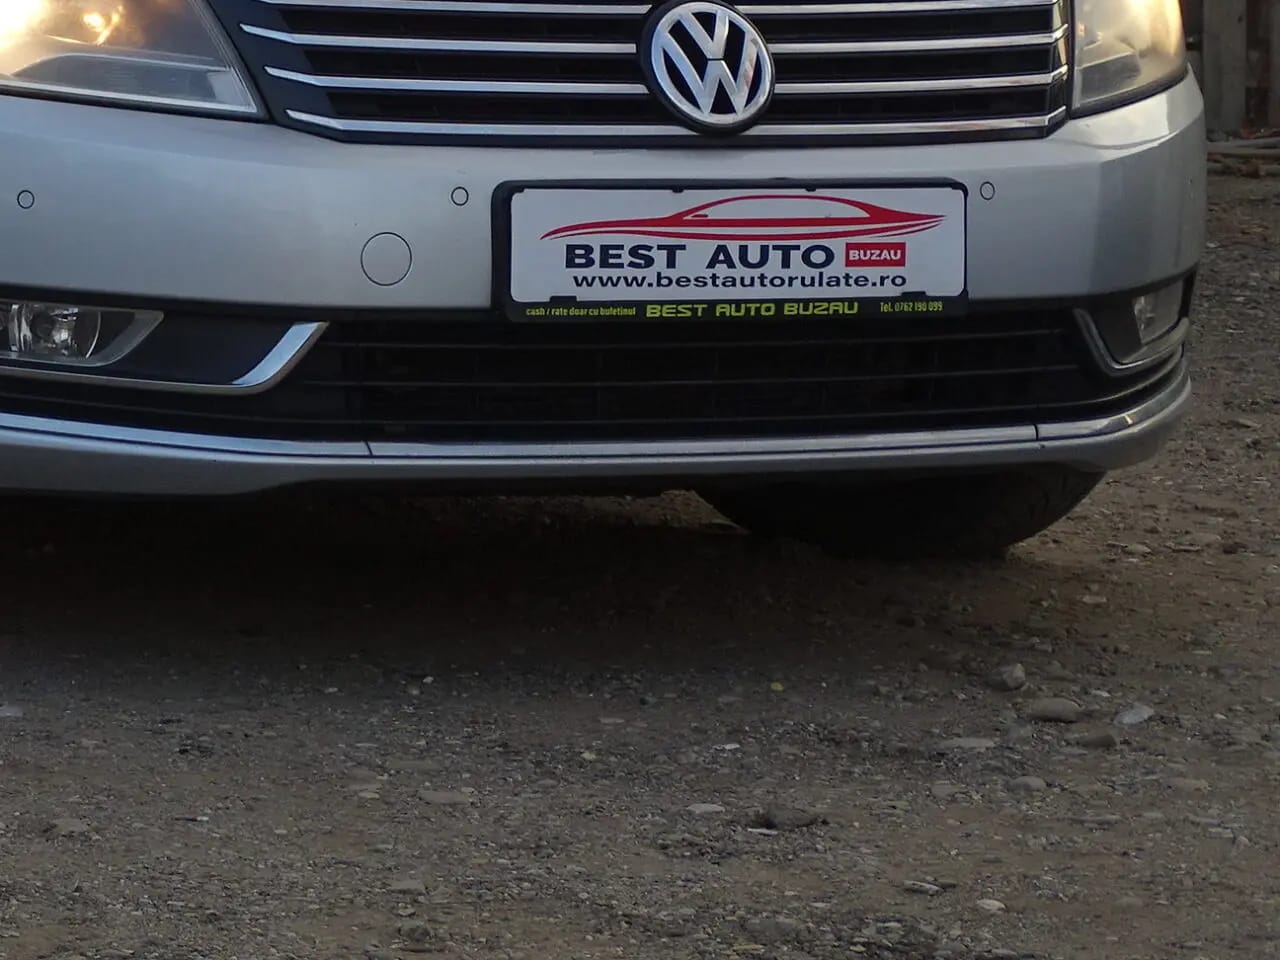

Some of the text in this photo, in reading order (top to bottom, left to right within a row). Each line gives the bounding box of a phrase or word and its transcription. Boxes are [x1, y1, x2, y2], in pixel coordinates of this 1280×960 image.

[565, 243, 902, 270] BEST AUTO BUZAU
[573, 272, 907, 289] www.bestautorulate.ro
[526, 306, 546, 316] cash
[551, 306, 569, 316] rate
[569, 306, 588, 316] doar
[589, 307, 600, 316] cu
[600, 305, 637, 317] buletinul
[645, 304, 708, 318] BEST
[715, 303, 777, 318] AUTO
[783, 301, 860, 316] BUZAU
[880, 301, 894, 313] Tel.
